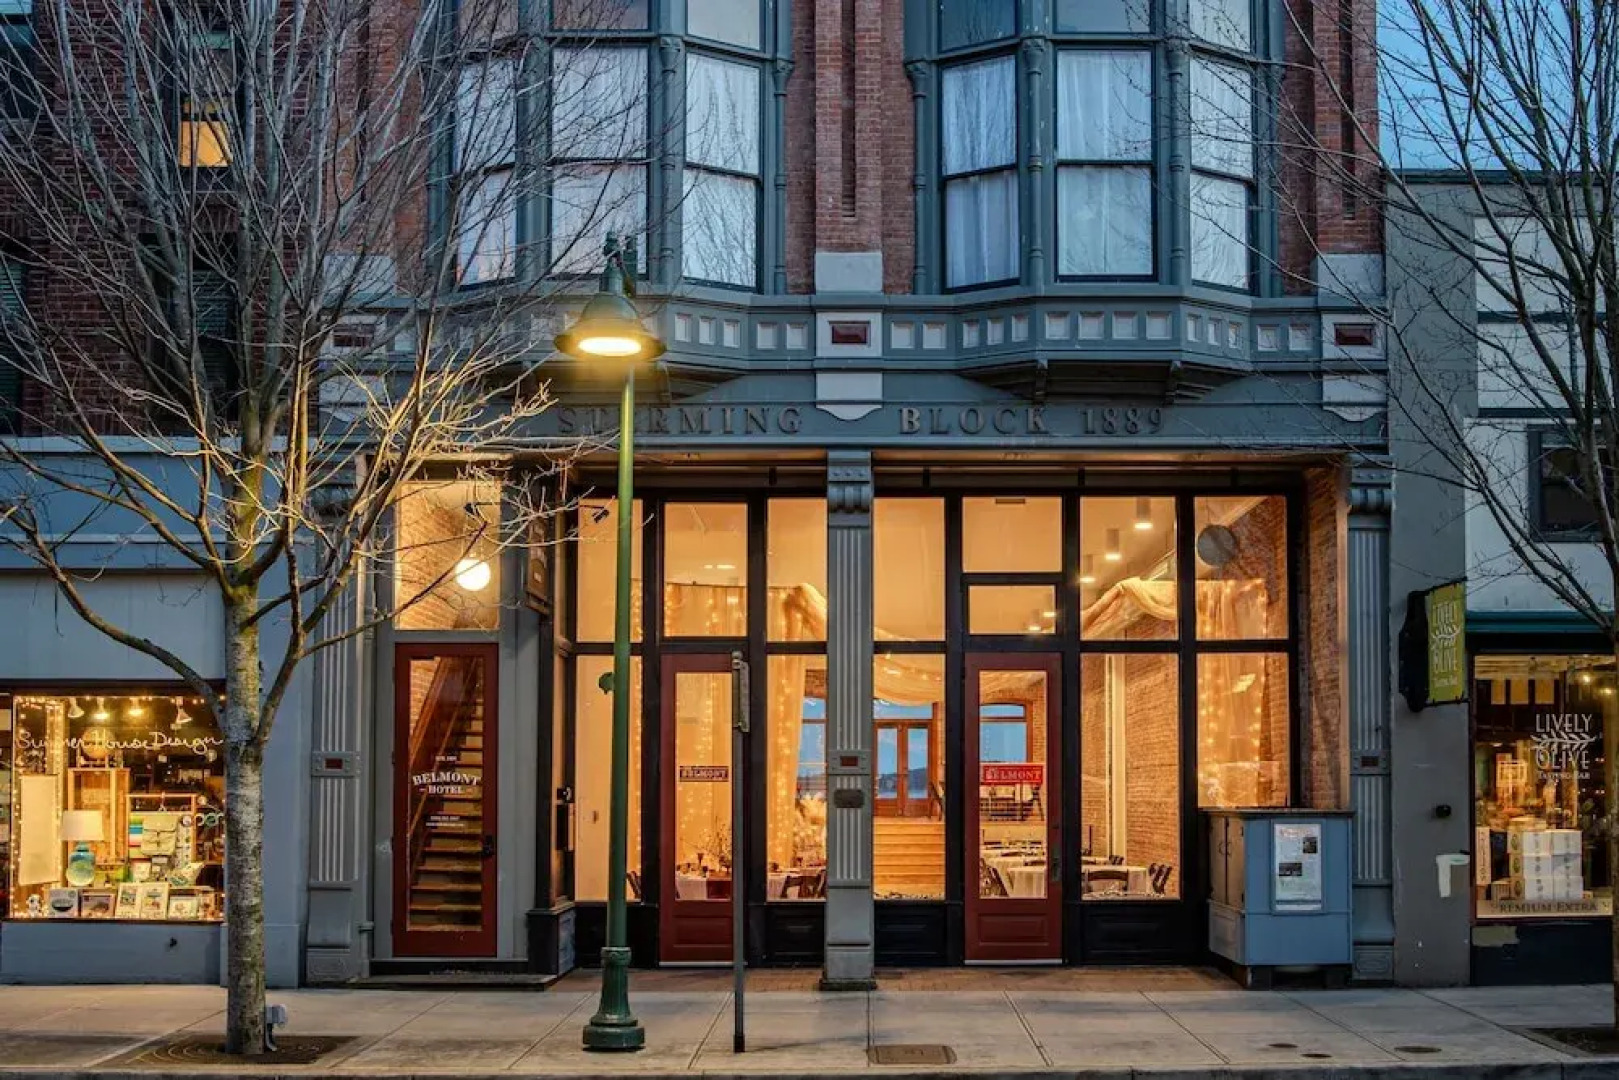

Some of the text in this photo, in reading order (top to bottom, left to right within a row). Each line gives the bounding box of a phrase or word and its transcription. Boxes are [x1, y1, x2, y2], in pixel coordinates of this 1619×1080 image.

[898, 407, 1050, 435] BLOCK
[1081, 407, 1165, 435] 1889
[1535, 713, 1592, 733] LIVELY
[16, 731, 86, 749] Suer
[149, 731, 224, 755] Design
[1535, 749, 1590, 770] OLIVE
[412, 771, 482, 786] BELMONT
[428, 785, 465, 794] HOTEL
